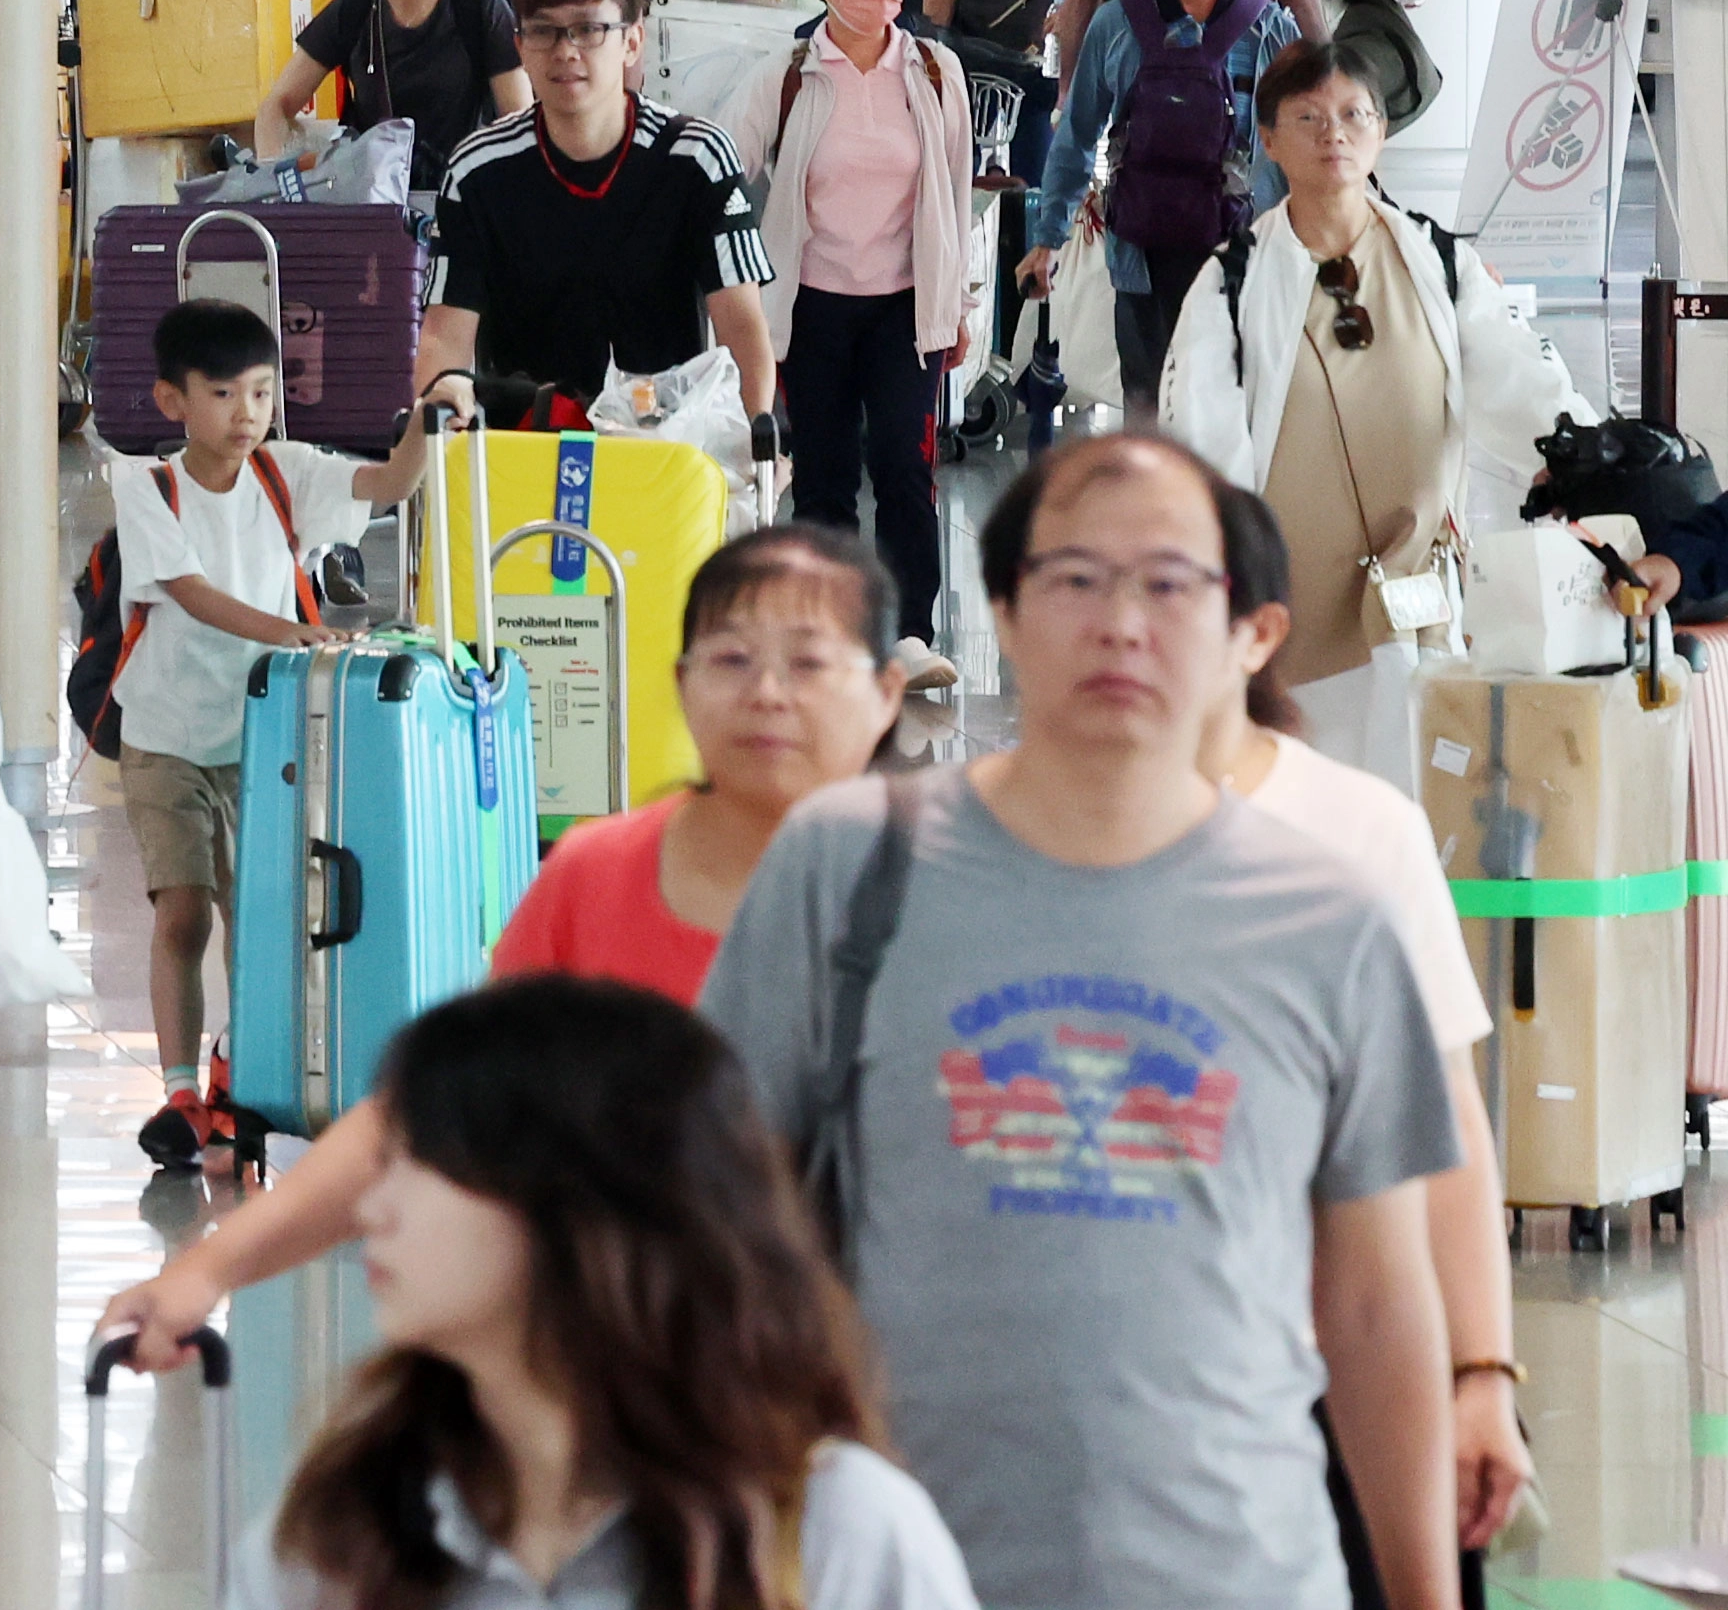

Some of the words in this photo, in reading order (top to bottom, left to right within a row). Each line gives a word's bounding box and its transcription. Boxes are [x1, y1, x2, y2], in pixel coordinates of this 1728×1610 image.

[497, 616, 562, 629] Prohibited
[564, 616, 600, 629] Items
[519, 635, 578, 647] Checklist
